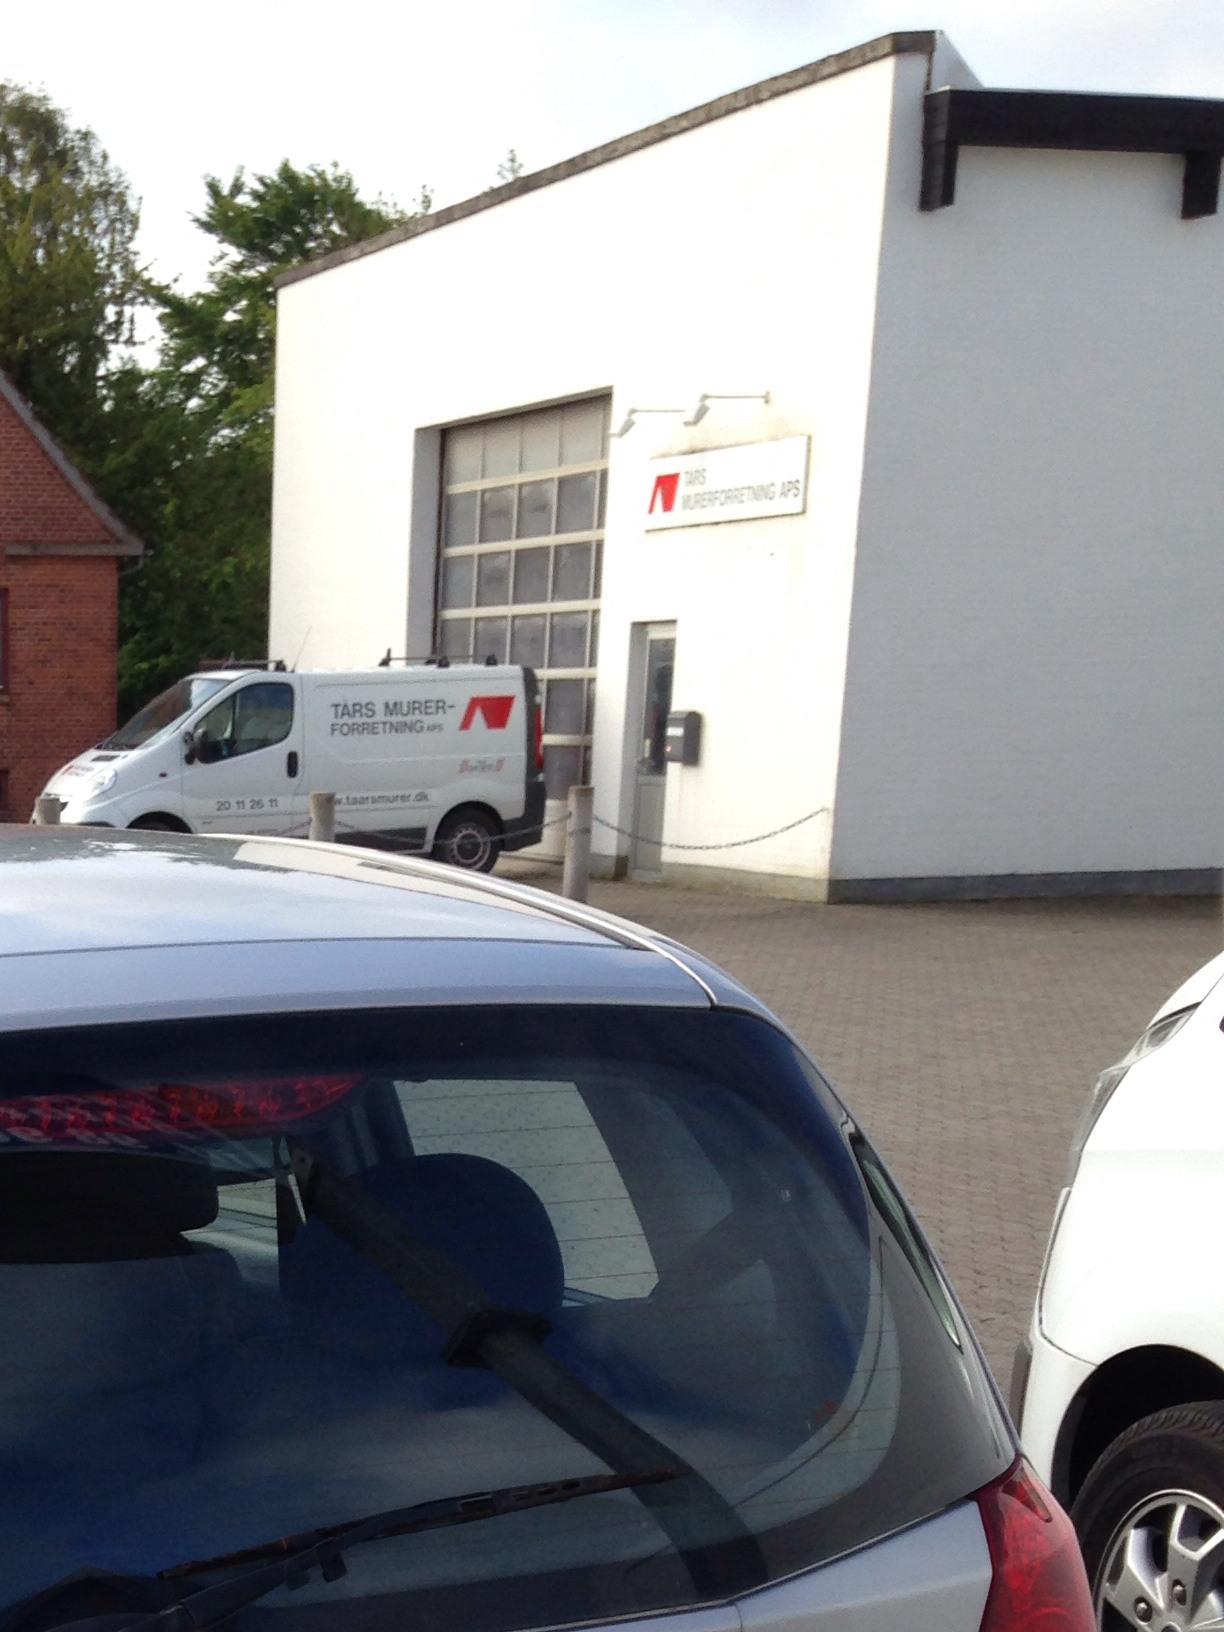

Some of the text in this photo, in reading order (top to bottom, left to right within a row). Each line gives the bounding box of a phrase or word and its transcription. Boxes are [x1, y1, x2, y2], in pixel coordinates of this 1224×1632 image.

[384, 698, 456, 717] MURER-
[329, 719, 424, 736] FORRETNING
[216, 800, 232, 812] 20
[249, 799, 265, 810] 26
